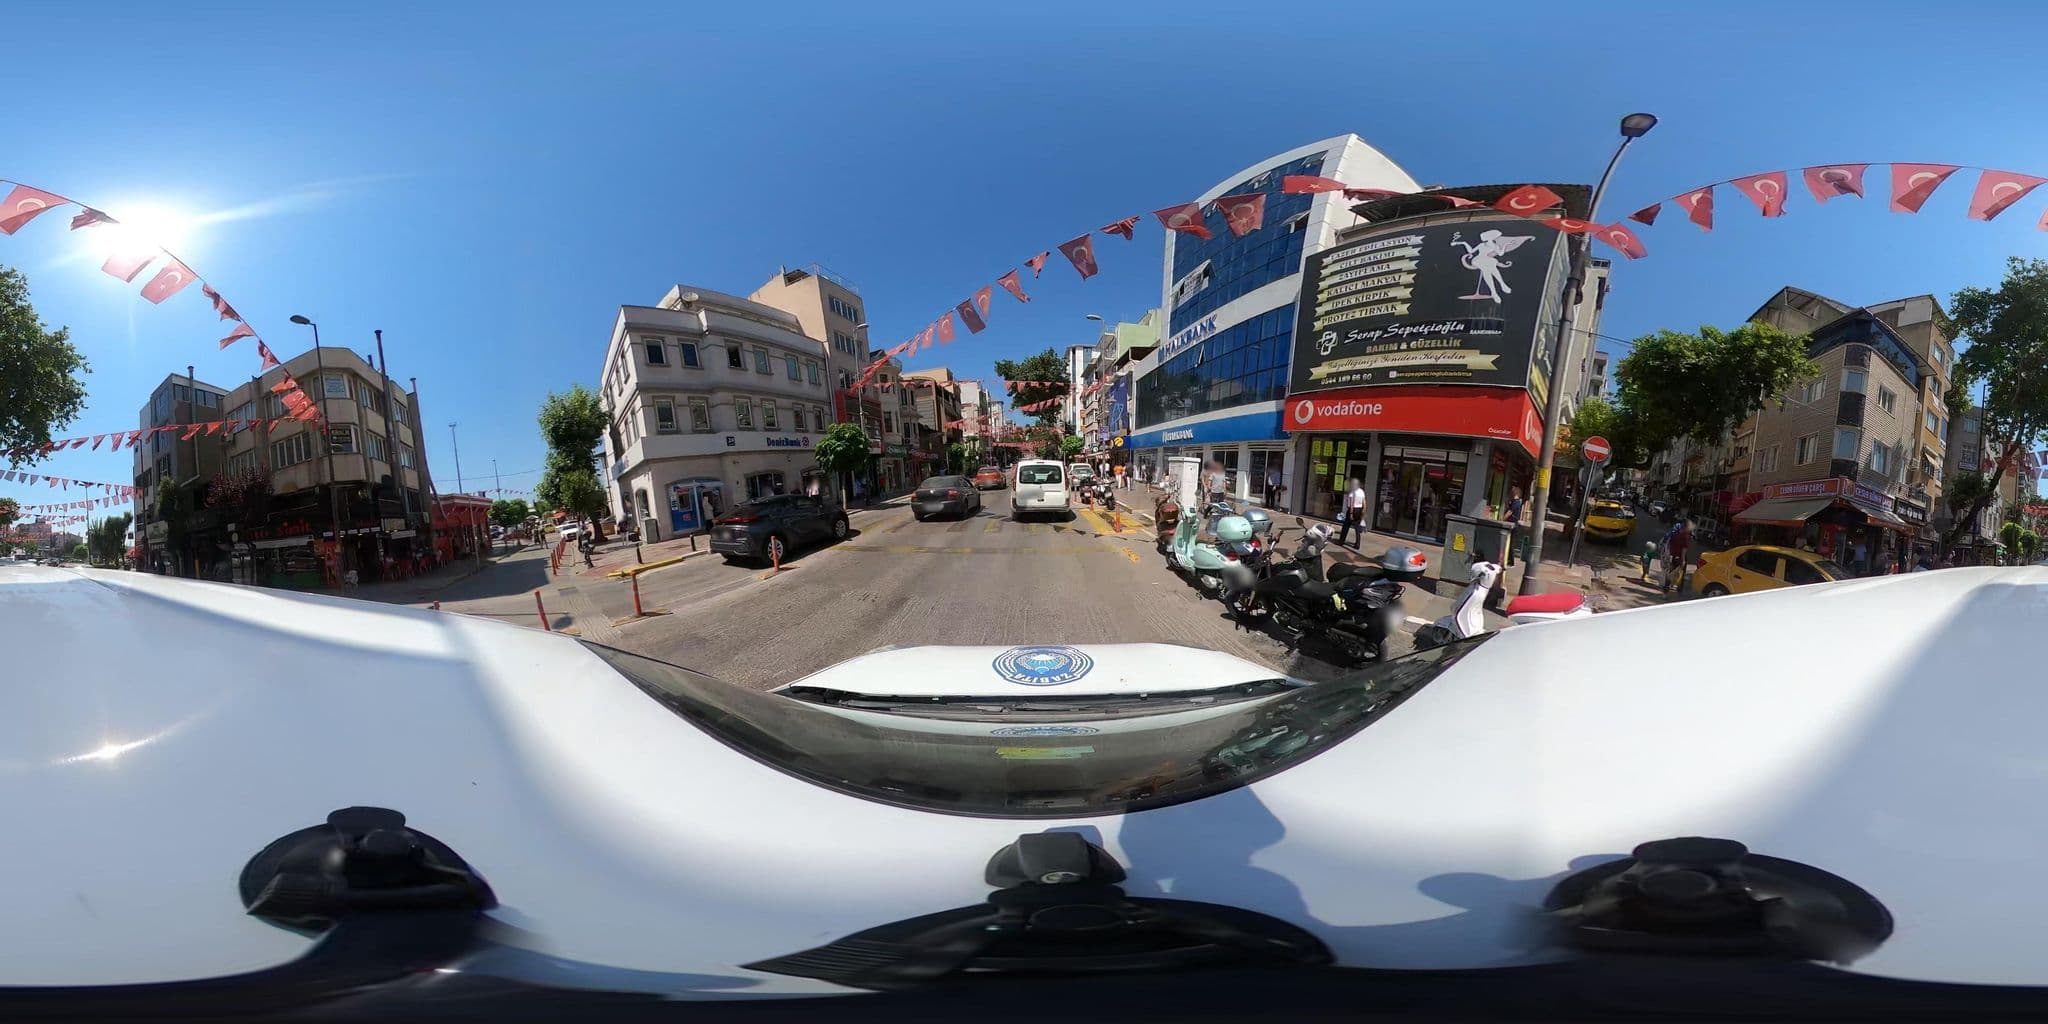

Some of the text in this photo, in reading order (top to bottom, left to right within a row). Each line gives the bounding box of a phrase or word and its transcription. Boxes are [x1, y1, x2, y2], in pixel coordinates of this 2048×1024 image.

[1321, 304, 1398, 324] PROTEZ TIRNAK
[1344, 321, 1465, 343] Serap Sepetçioğlu
[1366, 337, 1463, 353] BAKIM & GÜZELLİK
[1317, 400, 1383, 417] vodafone
[766, 436, 802, 447] DenizBank
[1013, 671, 1073, 684] ZABITA
